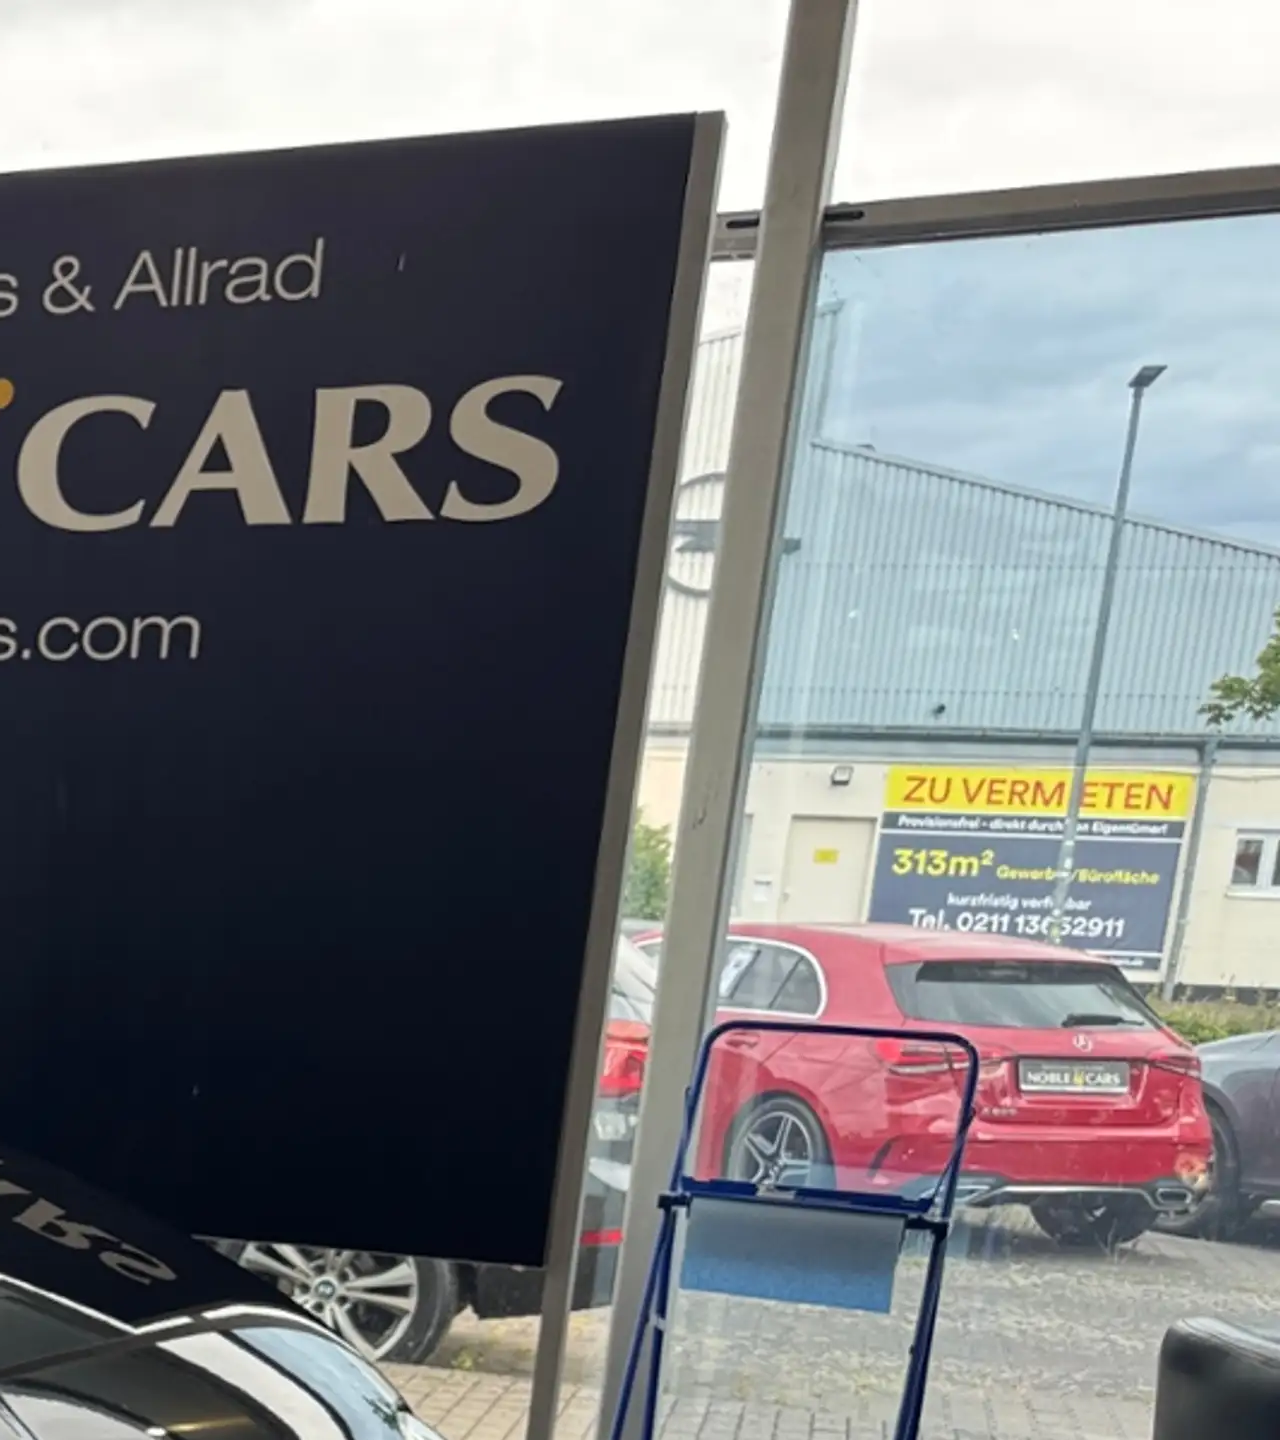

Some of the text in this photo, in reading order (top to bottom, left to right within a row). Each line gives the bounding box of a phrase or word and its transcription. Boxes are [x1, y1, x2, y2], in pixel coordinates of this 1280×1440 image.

[42, 255, 95, 315] &
[113, 236, 325, 311] Allrad
[17, 374, 563, 532] CARS
[903, 775, 1174, 811] ZU VERMETEN
[956, 912, 1009, 933] 0211
